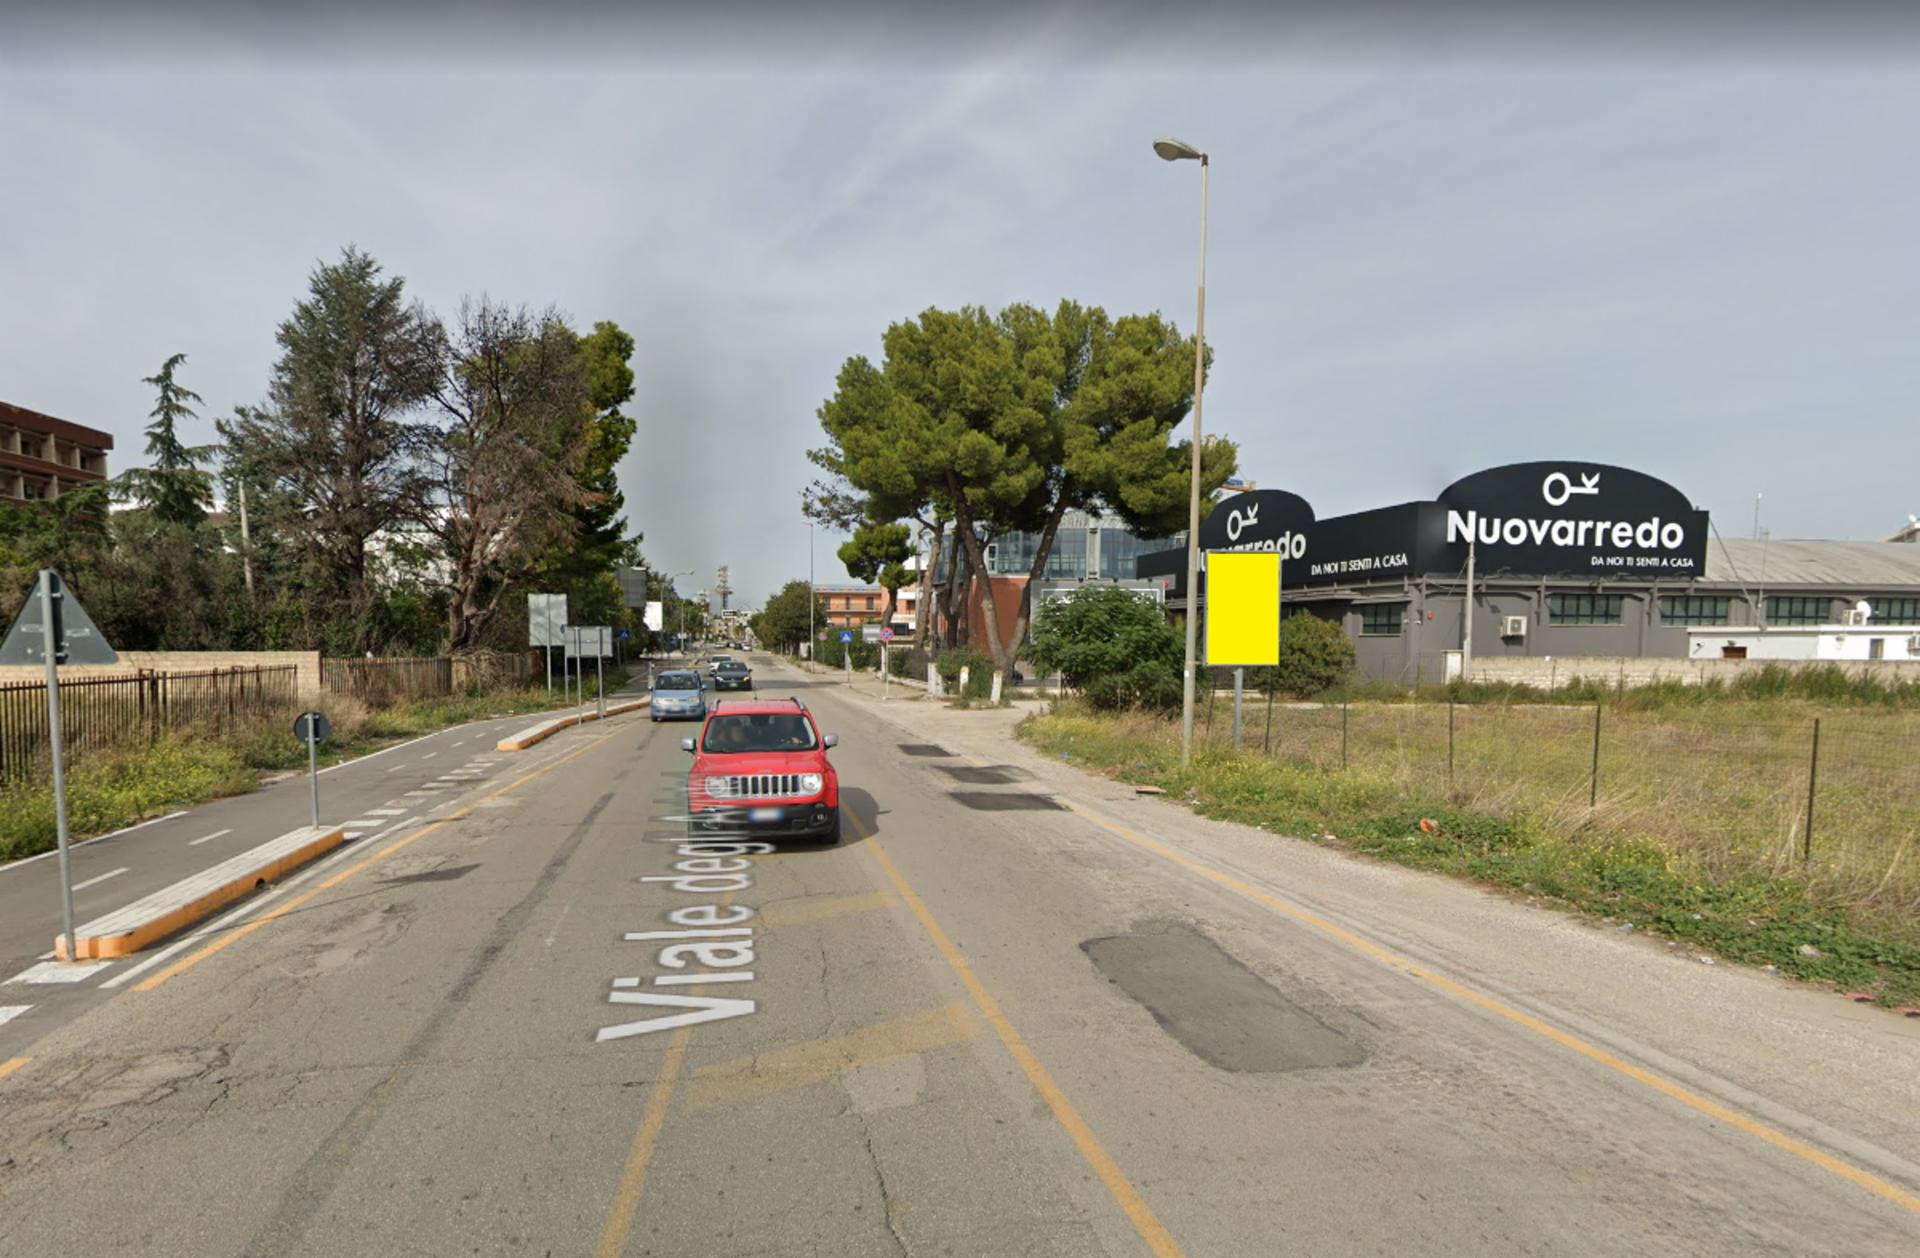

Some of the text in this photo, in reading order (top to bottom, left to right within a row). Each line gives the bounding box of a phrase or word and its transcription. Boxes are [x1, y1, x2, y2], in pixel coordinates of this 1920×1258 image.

[1446, 510, 1684, 549] Nuovarredo
[1373, 556, 1381, 569] A
[1382, 552, 1408, 568] CASA
[1661, 557, 1669, 567] A
[1670, 557, 1694, 567] CASA
